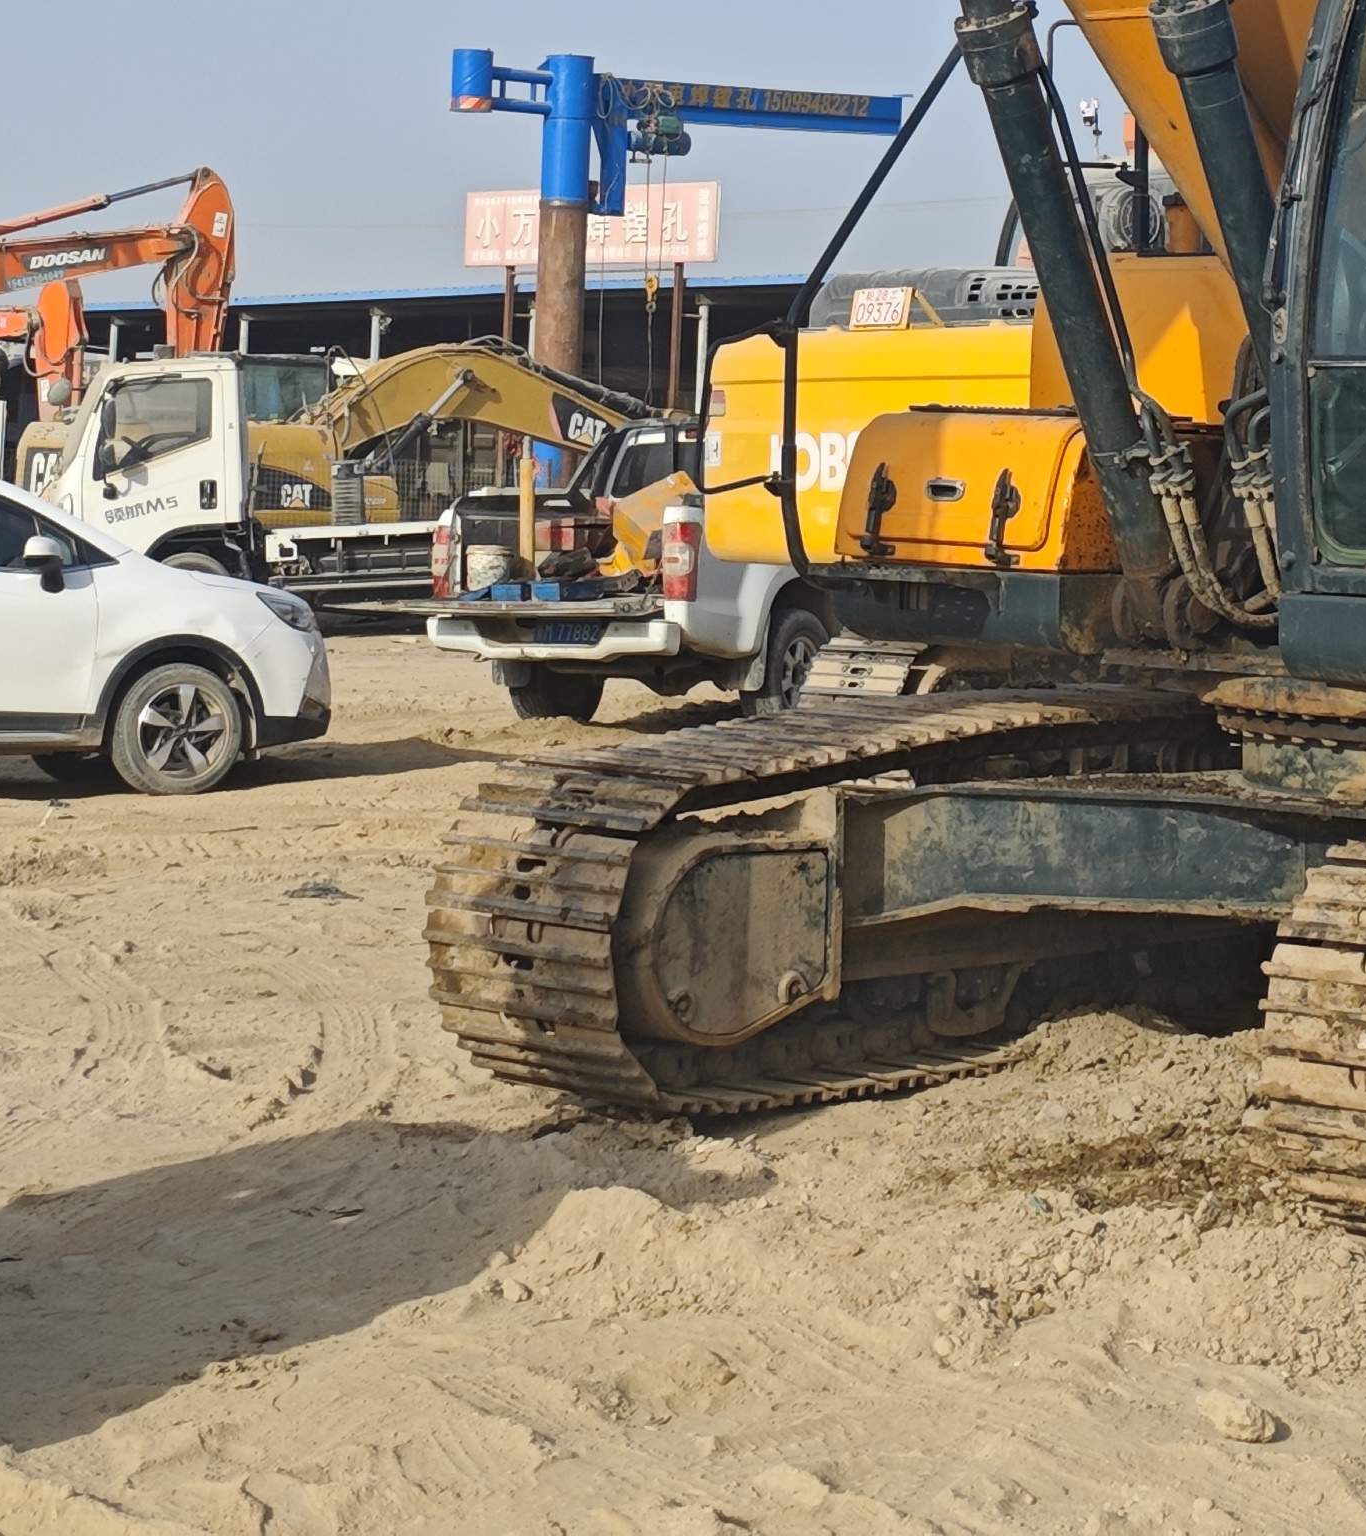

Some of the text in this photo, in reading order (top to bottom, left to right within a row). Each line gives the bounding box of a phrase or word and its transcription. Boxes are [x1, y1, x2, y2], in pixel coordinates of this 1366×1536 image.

[29, 247, 106, 270] DOOSAN
[856, 301, 900, 322] 09376
[567, 412, 607, 444] CAT
[280, 483, 313, 509] CAT
